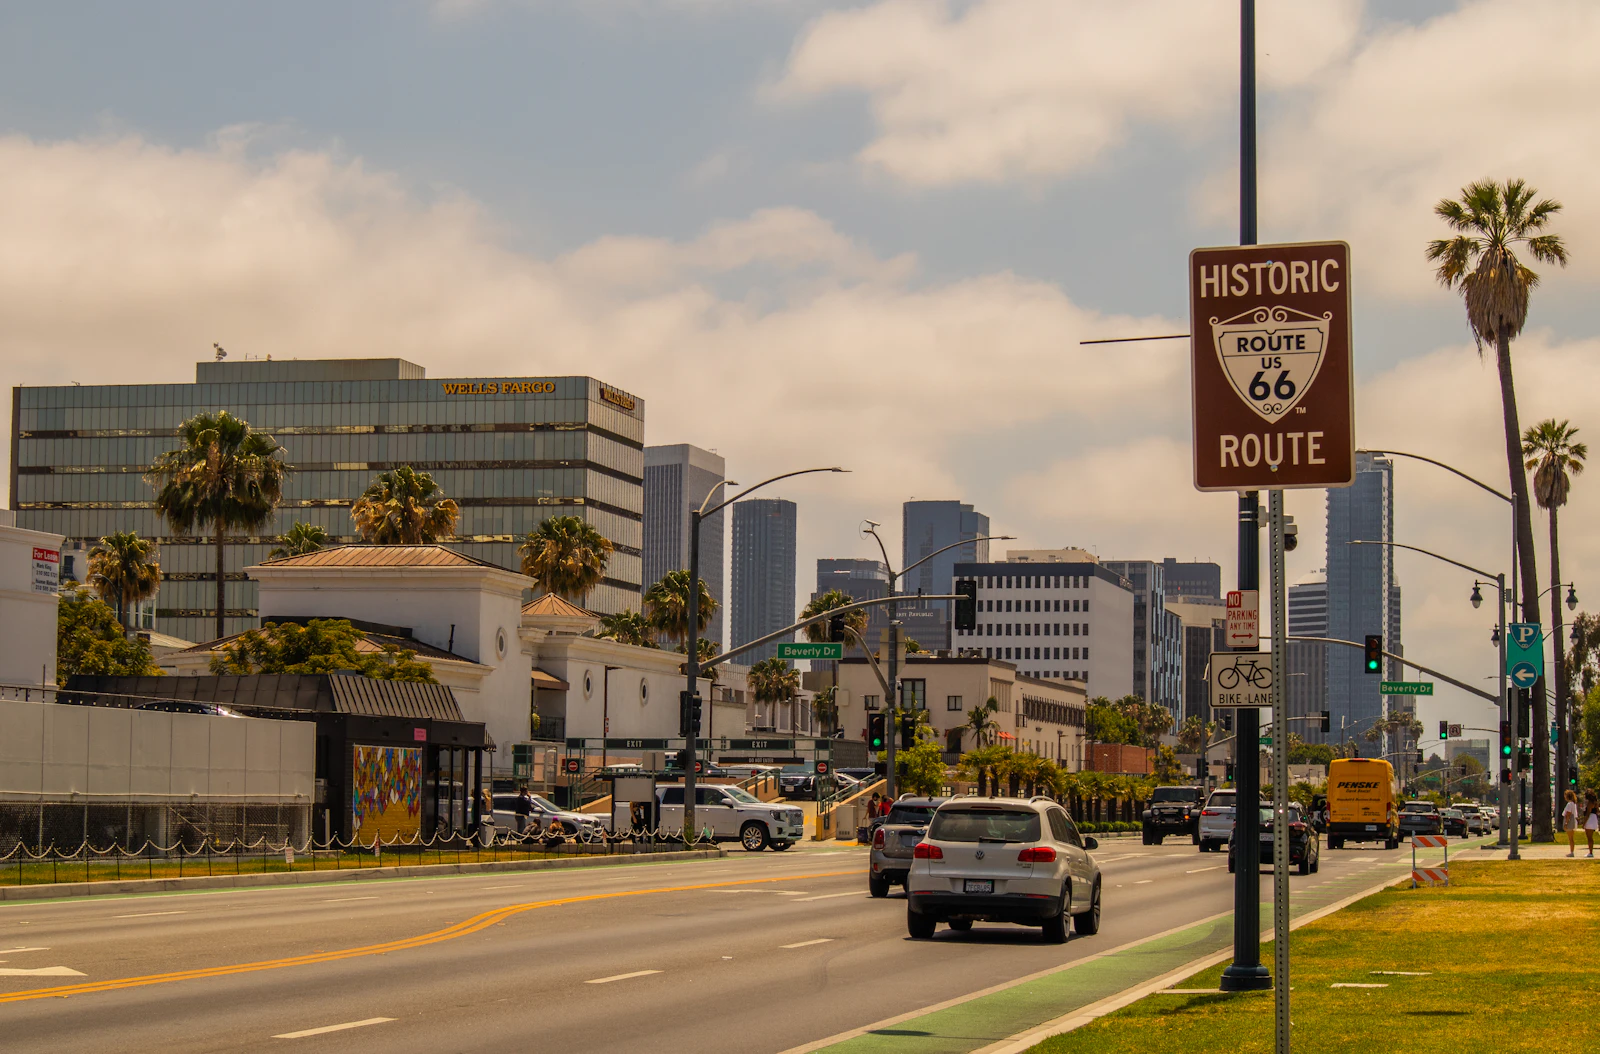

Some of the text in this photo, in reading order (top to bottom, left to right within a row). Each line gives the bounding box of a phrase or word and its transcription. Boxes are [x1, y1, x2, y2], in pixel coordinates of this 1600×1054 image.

[1200, 259, 1340, 298] HISTORIC
[1237, 334, 1306, 353] ROUTE
[1261, 357, 1282, 369] US
[442, 381, 555, 395] WELLS FARGO
[1249, 370, 1296, 401] 66
[1220, 431, 1326, 468] ROUTE
[34, 549, 43, 558] For
[1228, 593, 1240, 606] NO
[1228, 609, 1257, 621] PARKING
[1229, 621, 1255, 630] ANY TIME
[1518, 627, 1534, 643] P
[784, 646, 836, 658] Beverly Dr
[1381, 684, 1431, 694] Beverly Dr
[1219, 693, 1242, 704] BIKE
[626, 740, 643, 748] EXIT
[752, 740, 768, 748] EXIT
[1337, 781, 1380, 789] PENSKE
